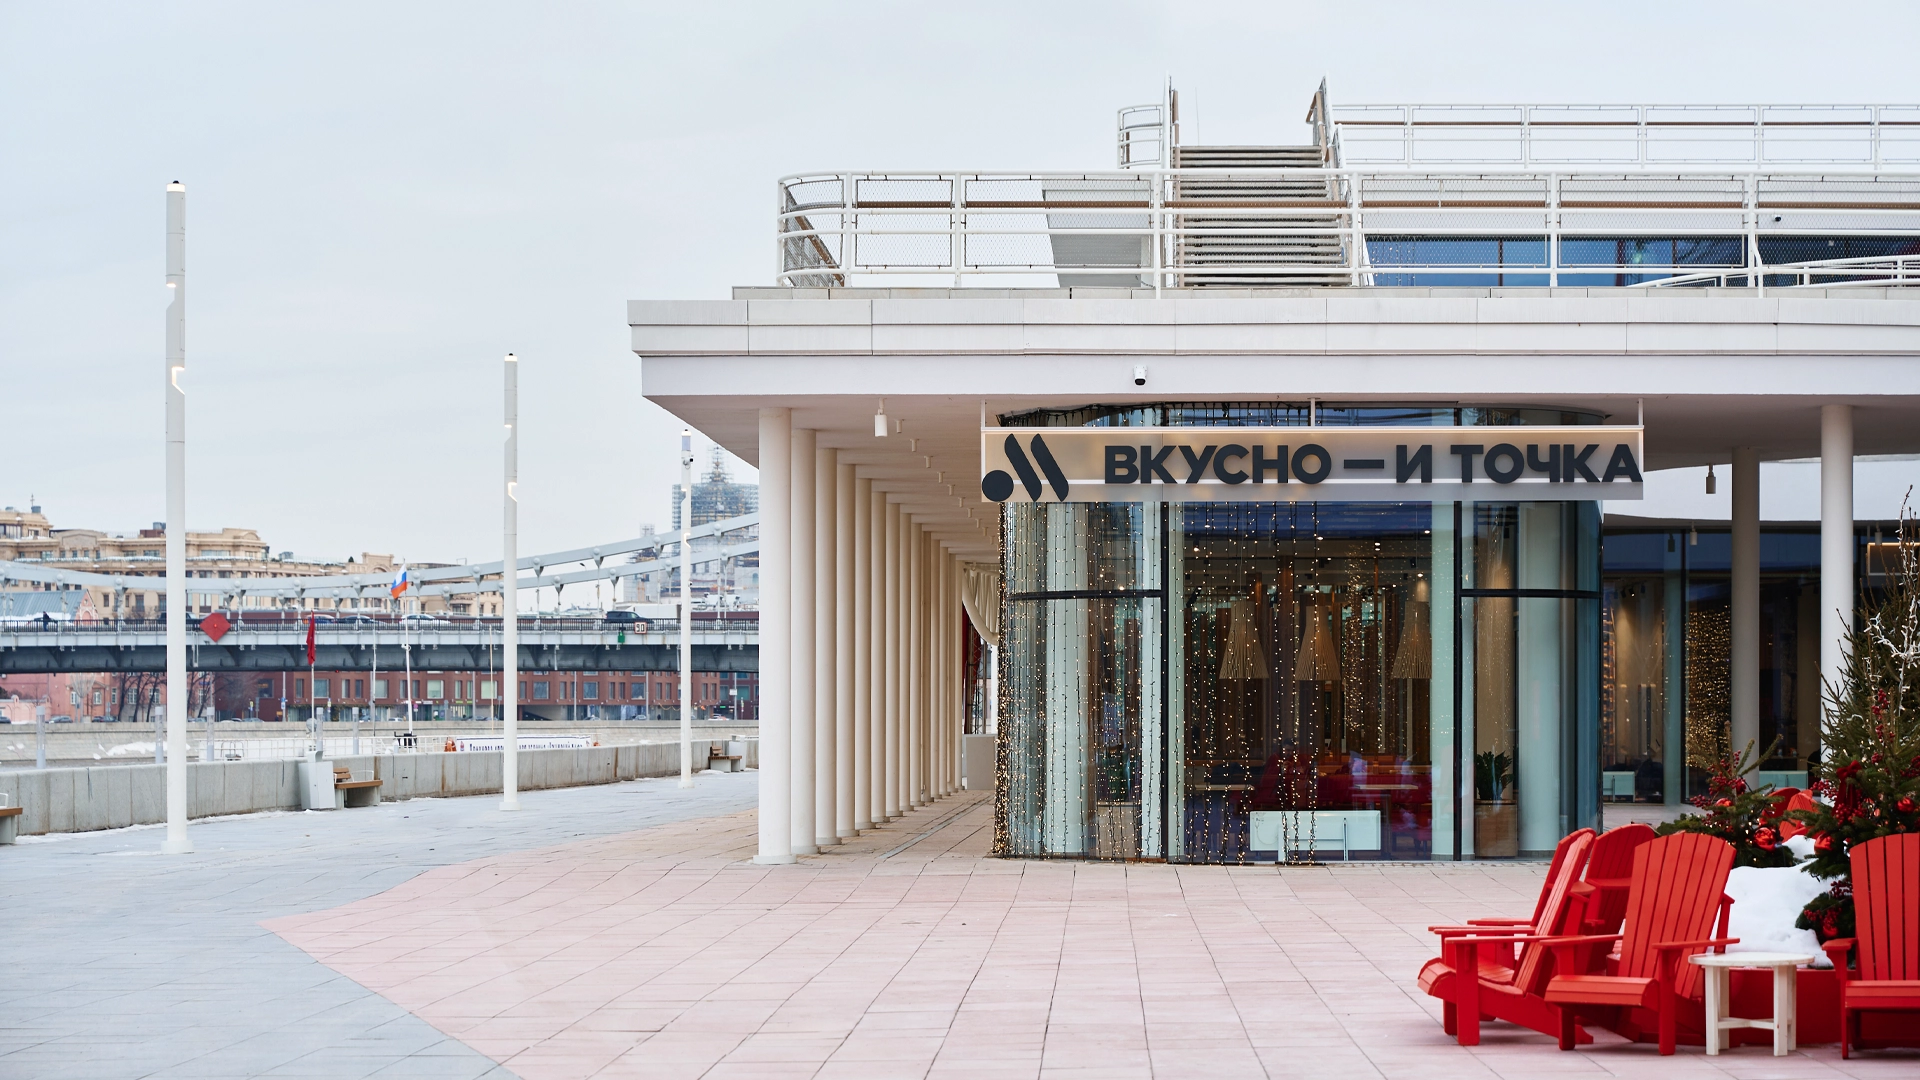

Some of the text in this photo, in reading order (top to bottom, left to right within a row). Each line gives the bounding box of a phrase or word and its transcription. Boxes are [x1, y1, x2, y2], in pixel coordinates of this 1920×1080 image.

[1104, 443, 1333, 486] ВКУСНО
[1395, 444, 1433, 484] И
[1449, 443, 1644, 486] ТОЧКА
